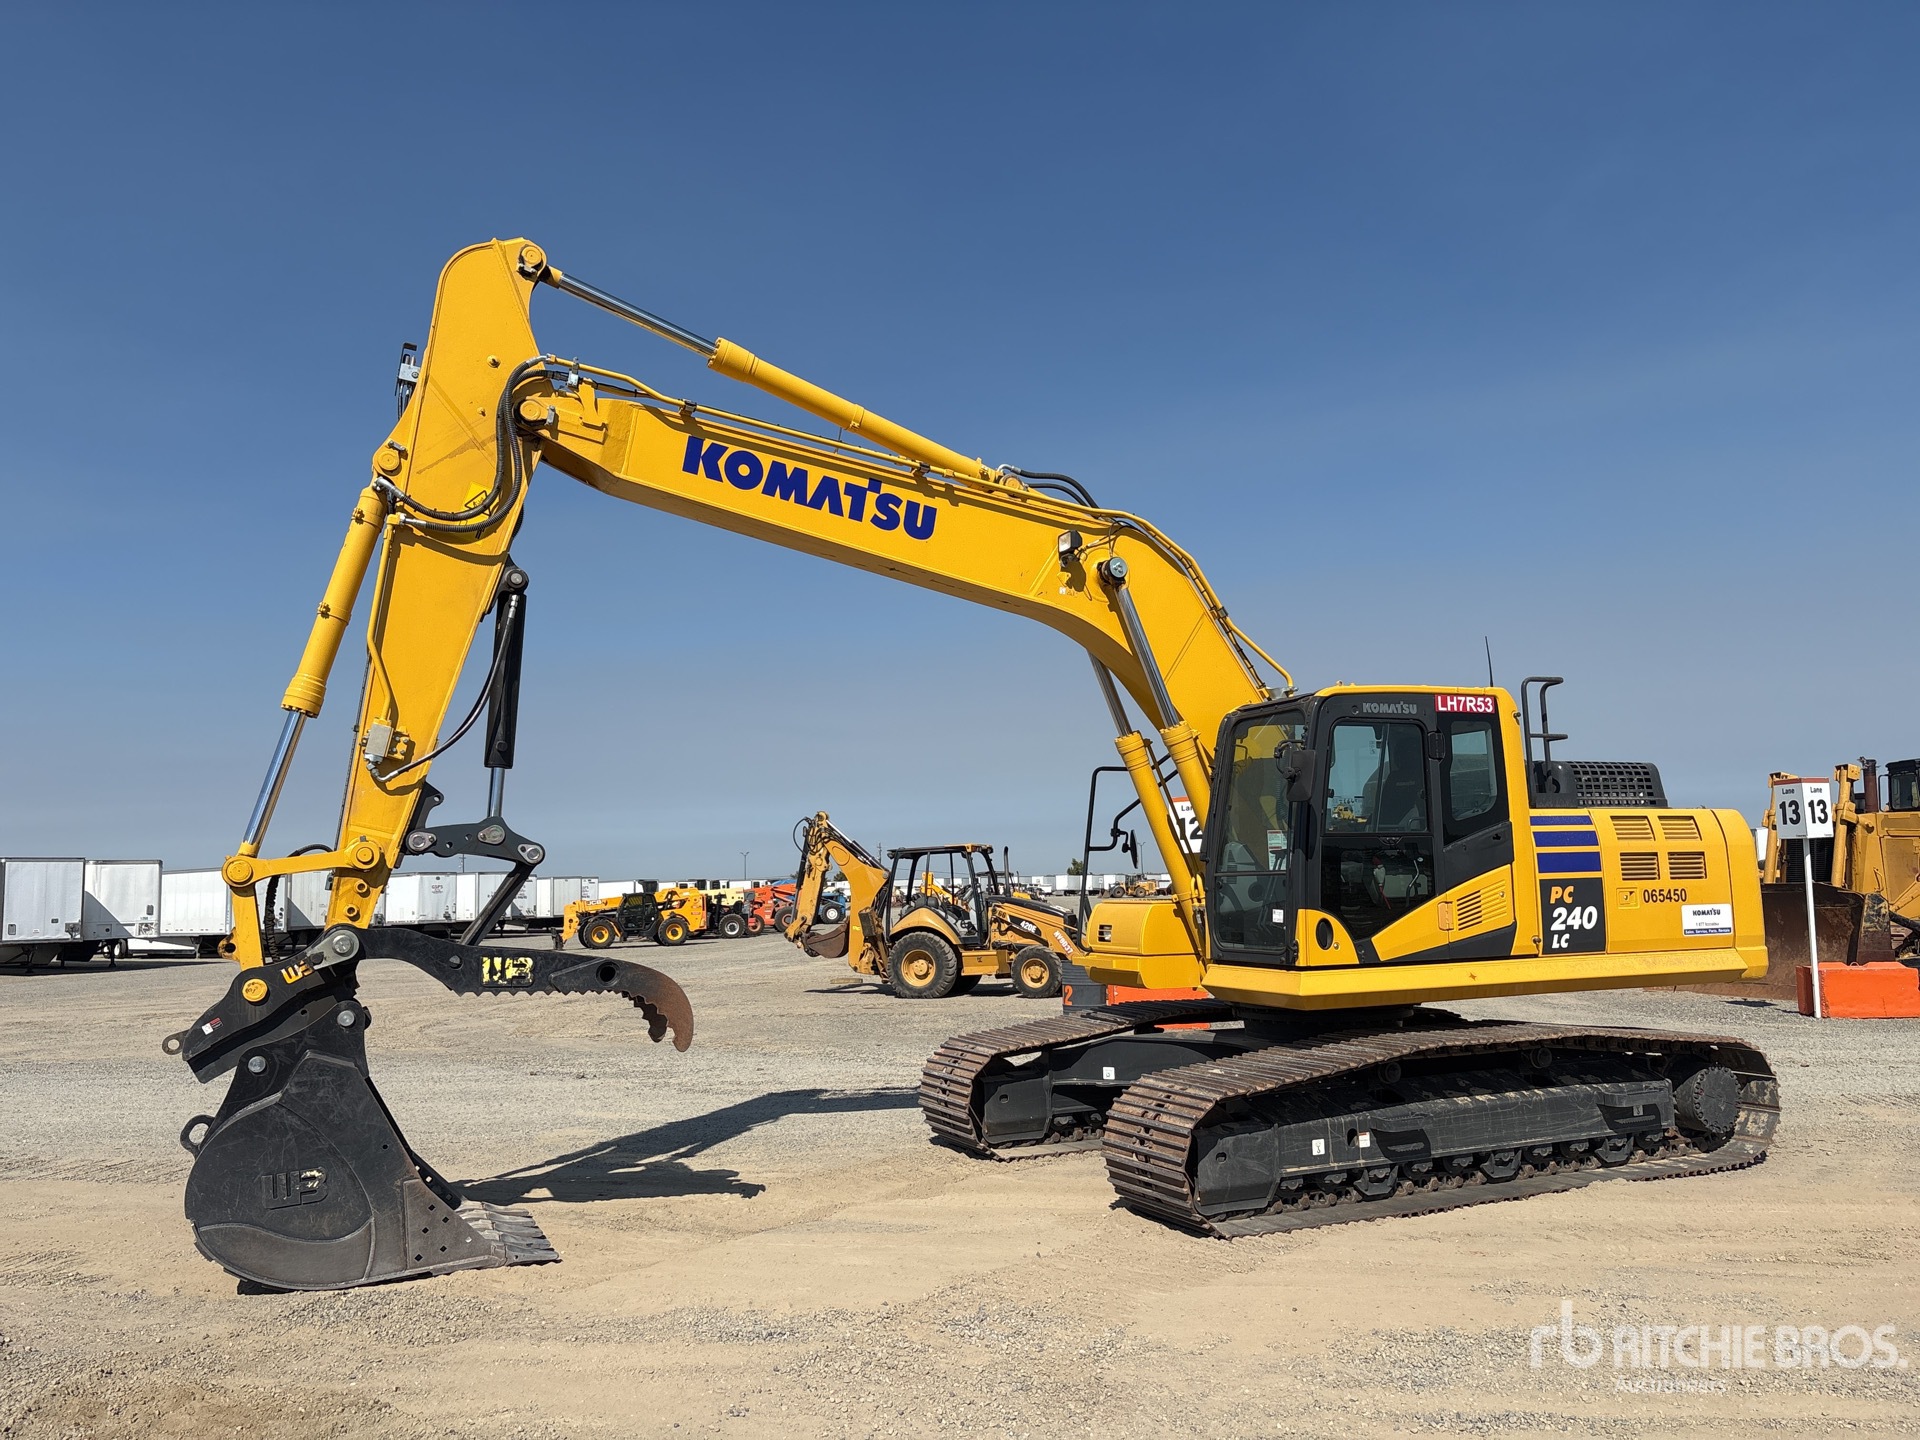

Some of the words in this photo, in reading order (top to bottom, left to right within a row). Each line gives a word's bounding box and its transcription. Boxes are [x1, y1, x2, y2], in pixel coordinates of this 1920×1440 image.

[682, 435, 938, 541] KOMATSU
[1363, 701, 1417, 714] KOMATSU
[1437, 695, 1494, 713] LH7R53
[1779, 800, 1801, 825] 13
[1808, 799, 1828, 824] 13
[1550, 886, 1574, 904] PC
[1643, 888, 1687, 903] 065450
[1550, 905, 1598, 931] 240
[1692, 908, 1721, 917] KOMATSU
[1020, 921, 1037, 933] 420E
[1551, 933, 1570, 949] LC
